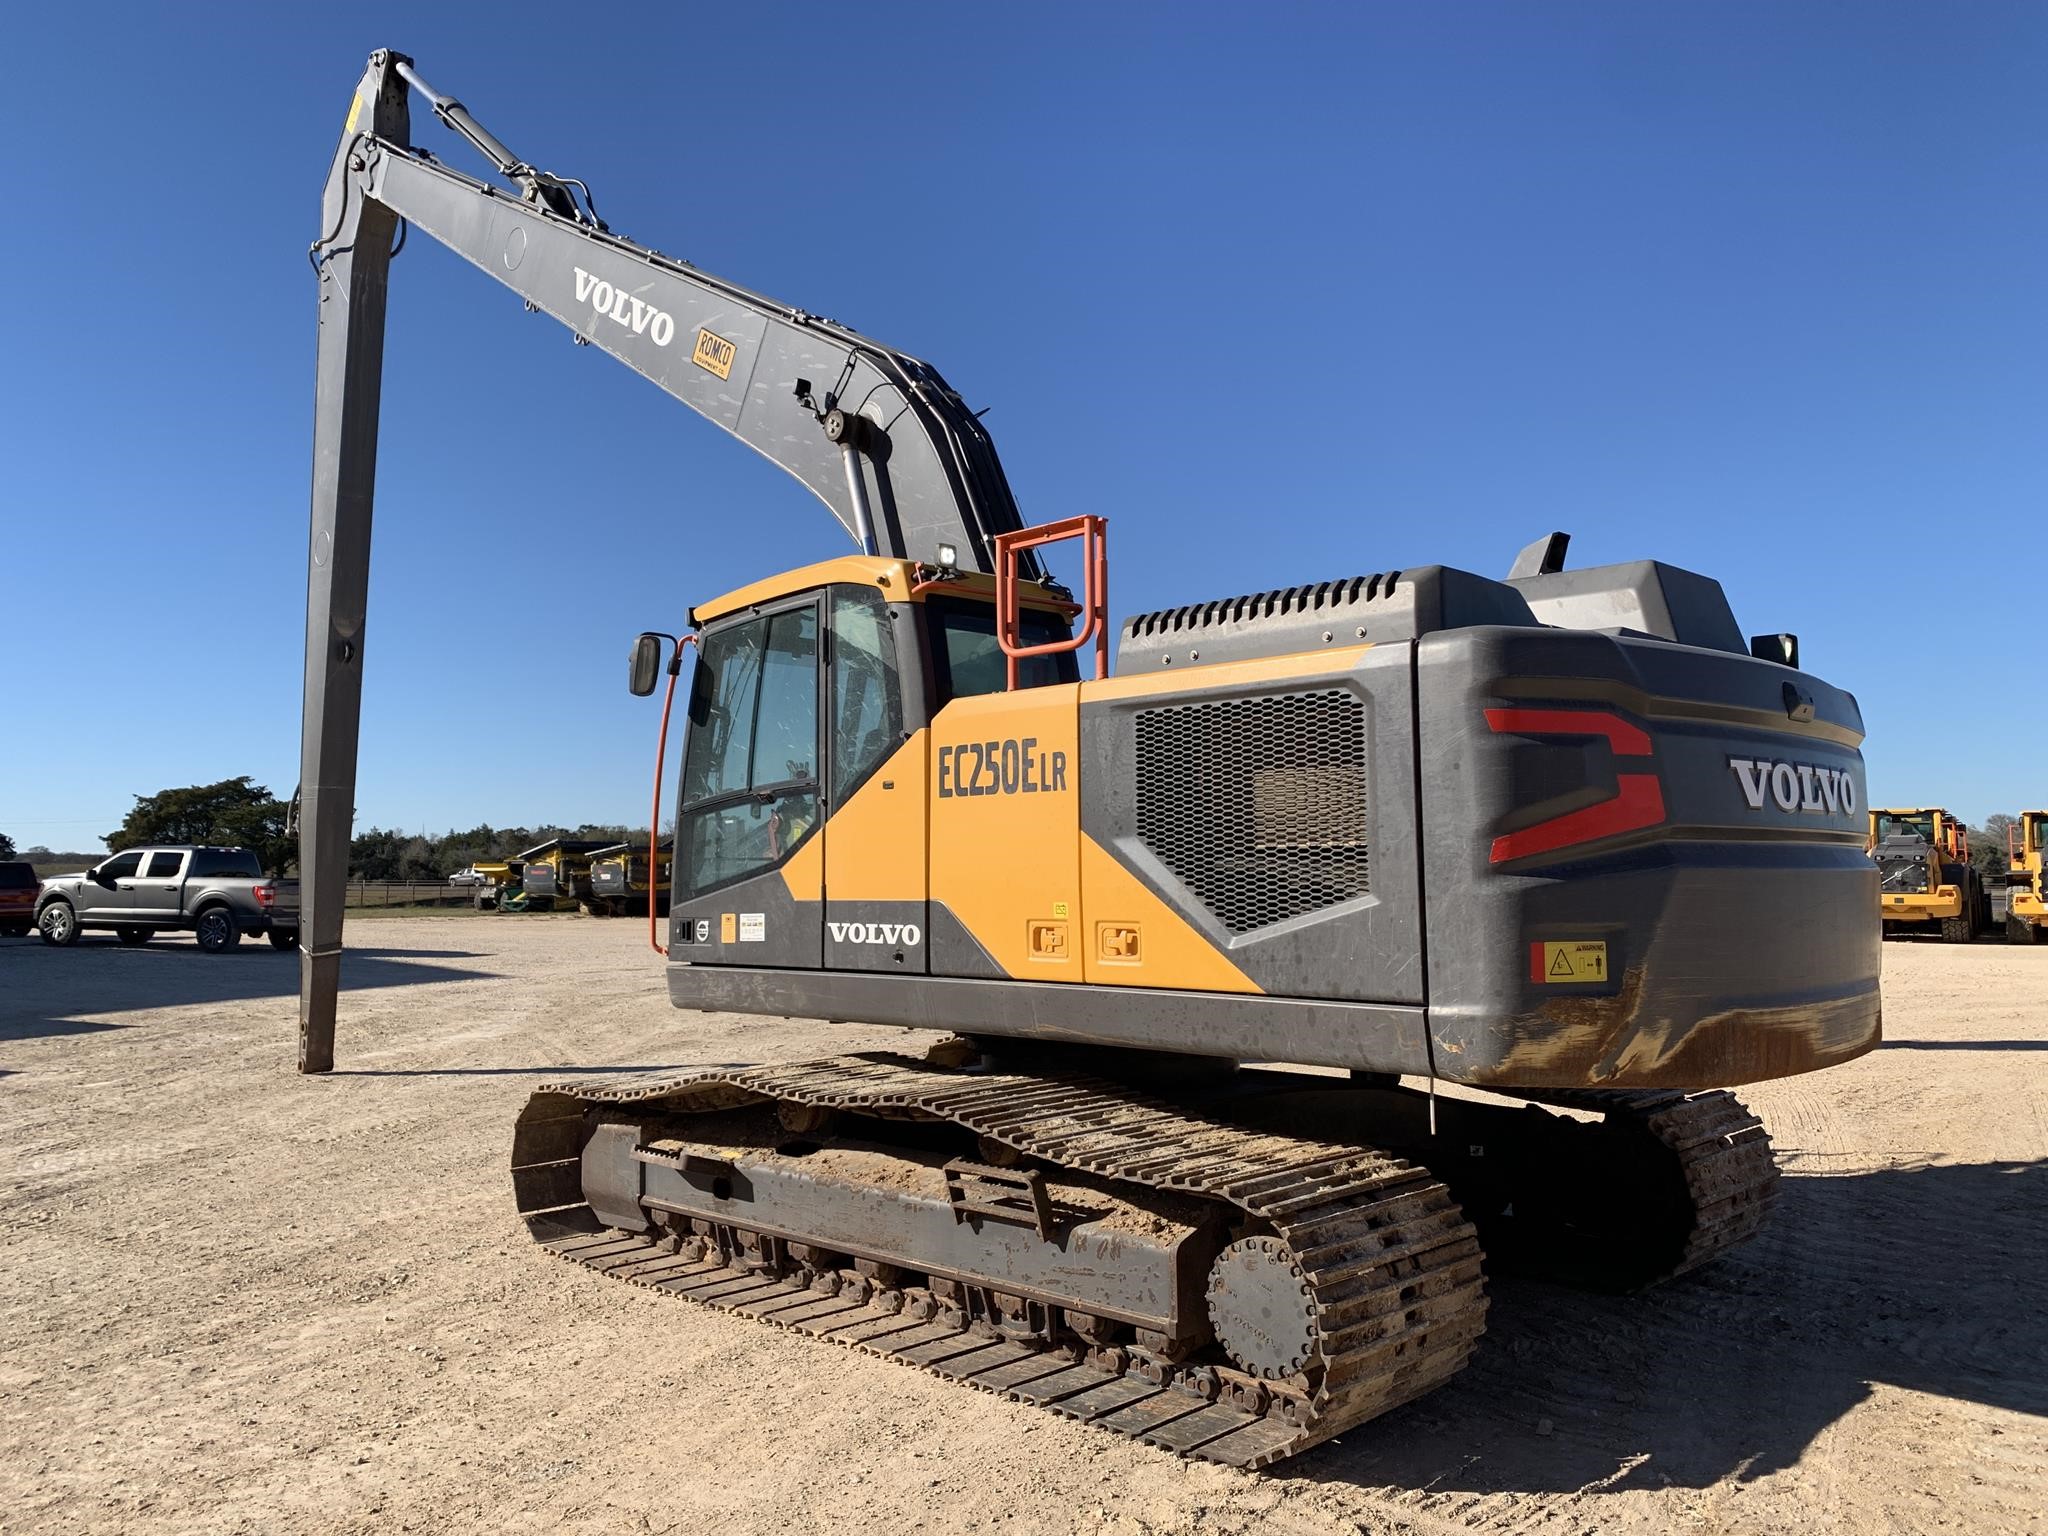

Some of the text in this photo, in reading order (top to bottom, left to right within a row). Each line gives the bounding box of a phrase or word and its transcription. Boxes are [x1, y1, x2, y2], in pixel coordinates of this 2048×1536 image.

[574, 266, 674, 346] VOLVO
[699, 333, 731, 366] ROMCO
[1729, 758, 1856, 816] VOLVO
[827, 922, 921, 946] VOLVO
